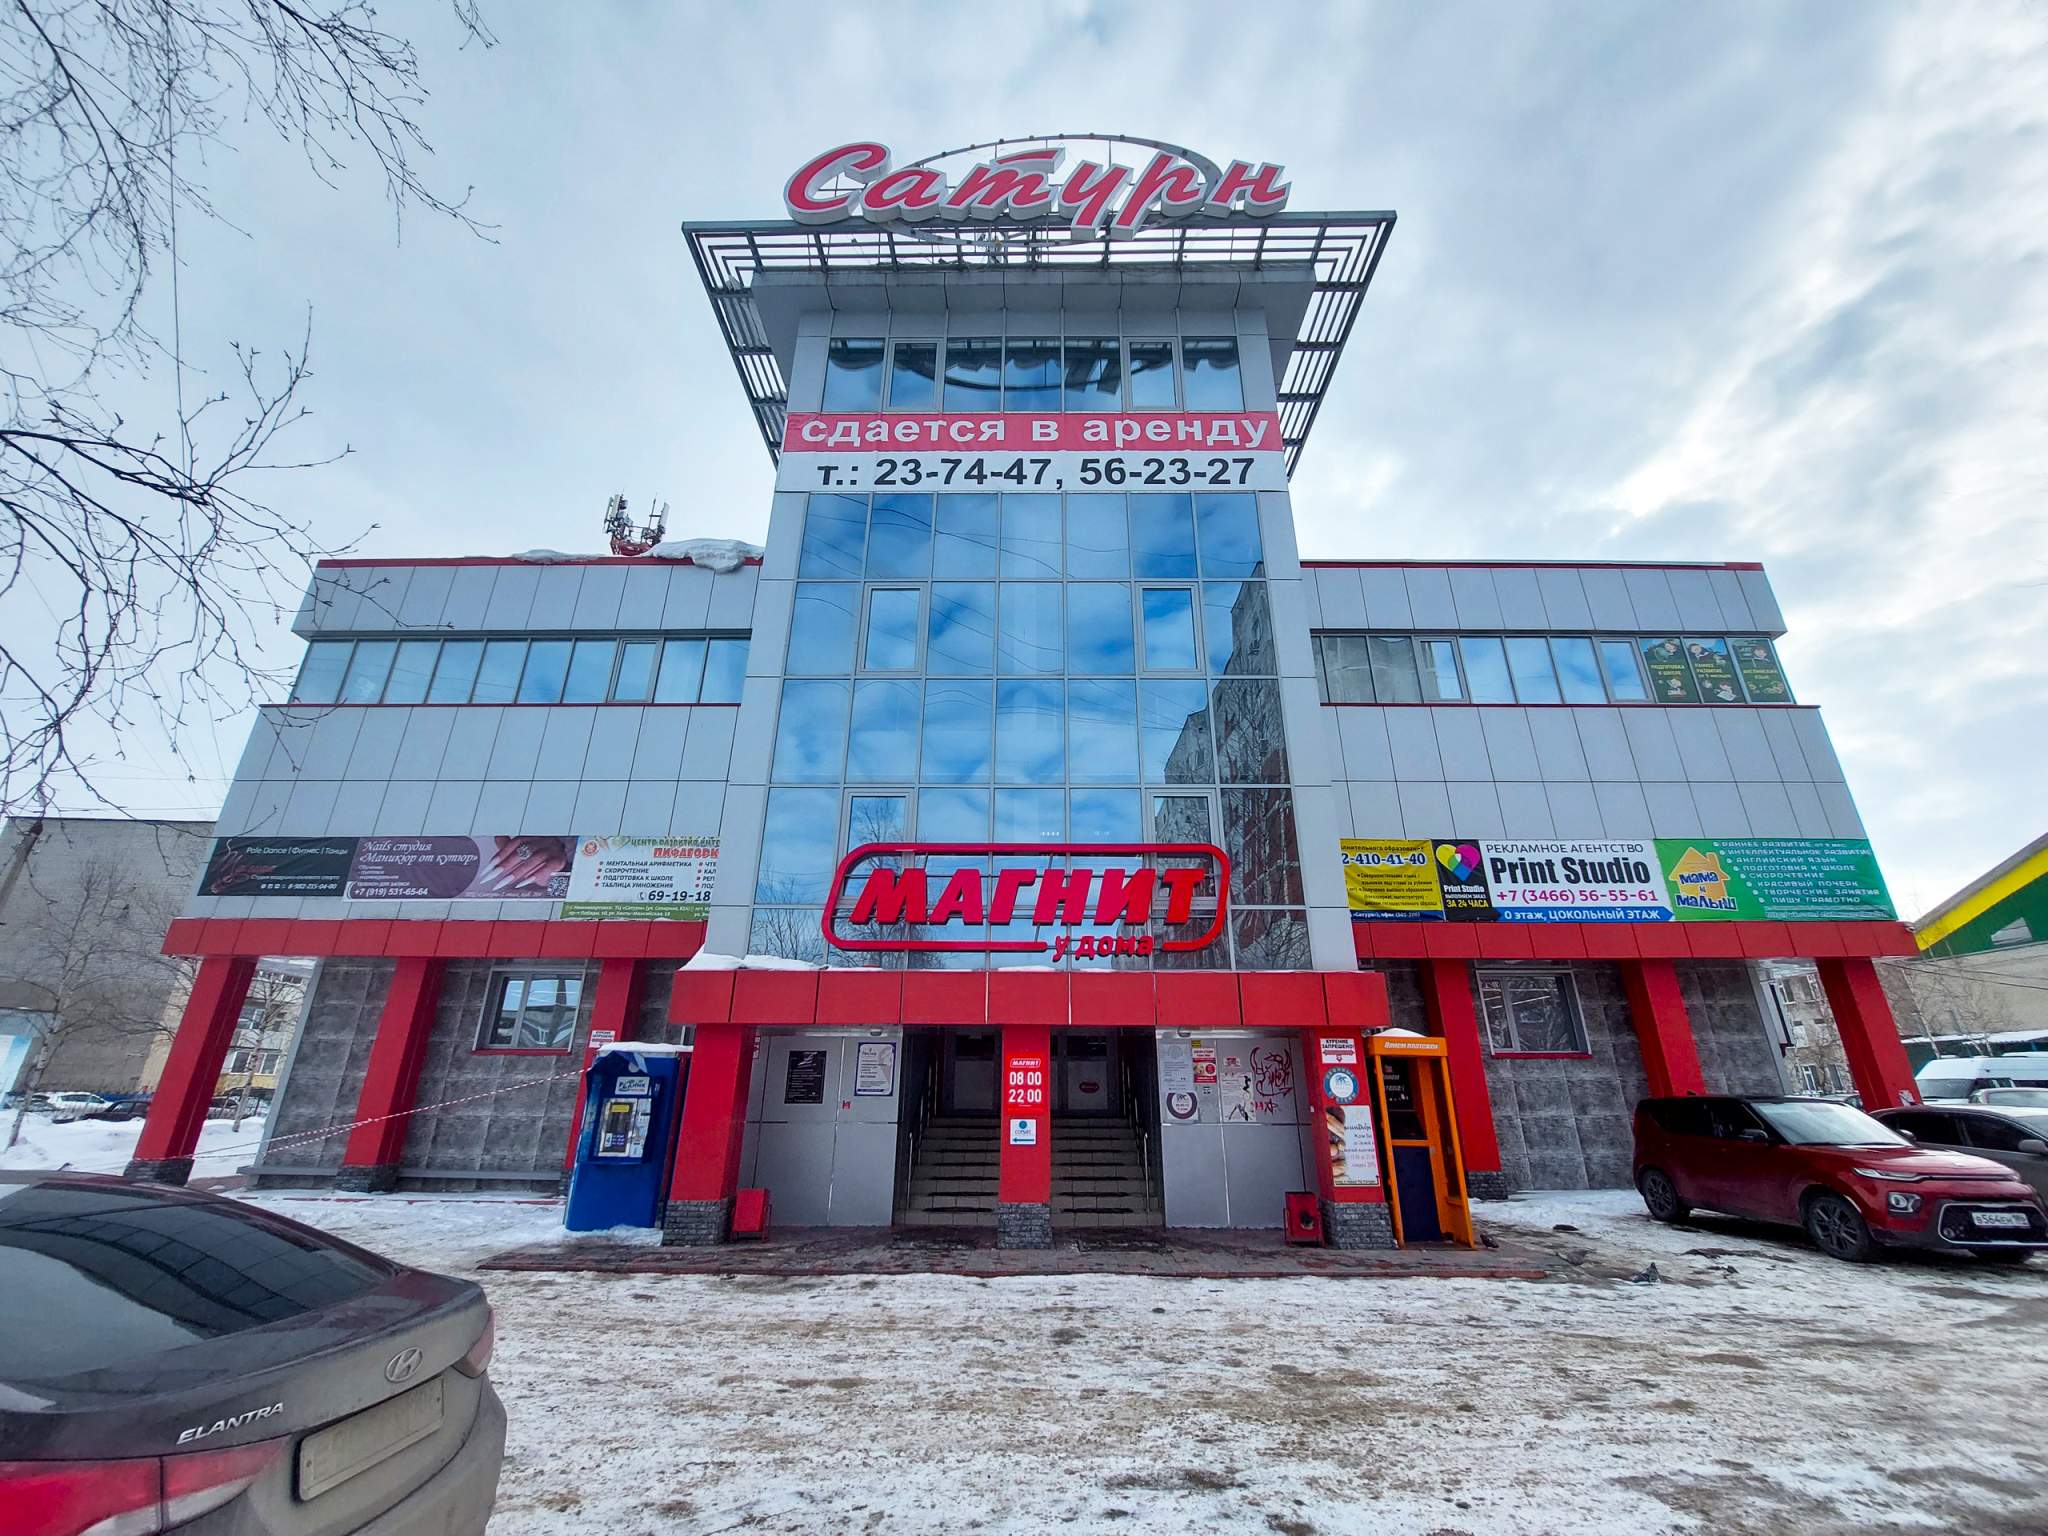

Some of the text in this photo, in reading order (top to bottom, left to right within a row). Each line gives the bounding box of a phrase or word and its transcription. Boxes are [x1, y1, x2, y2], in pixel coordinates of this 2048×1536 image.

[784, 140, 1292, 241] Сатурн
[801, 418, 1270, 448] сдается в аренду
[876, 458, 1064, 490] 23-74-47,
[1080, 457, 1256, 486] 56-23-27
[263, 846, 287, 854] Dance
[363, 840, 433, 854] Nails студия
[1486, 843, 1644, 854] РЕКЛАМНОЕ АГЕНТСТВО
[1489, 856, 1651, 884] Print Studio
[366, 887, 387, 897] (919)
[388, 887, 429, 896] 531-65-64
[1443, 884, 1462, 892] Print
[648, 890, 711, 901] 69-19-18
[849, 868, 1206, 926] МАГНИТ
[1497, 889, 1658, 905] +7 (3466) 56-55-61
[1446, 899, 1489, 908] ЗА 24 ЧАСА
[1513, 911, 1547, 921] этаж,
[1548, 909, 1619, 922] ЦОКОЛЬНЫЙ
[1622, 910, 1661, 920] ЭТАЖ
[1052, 934, 1155, 962] у дома
[1009, 1071, 1042, 1086] 08 00
[1008, 1089, 1042, 1103] 22 00
[176, 1401, 284, 1446] ELANTRA
